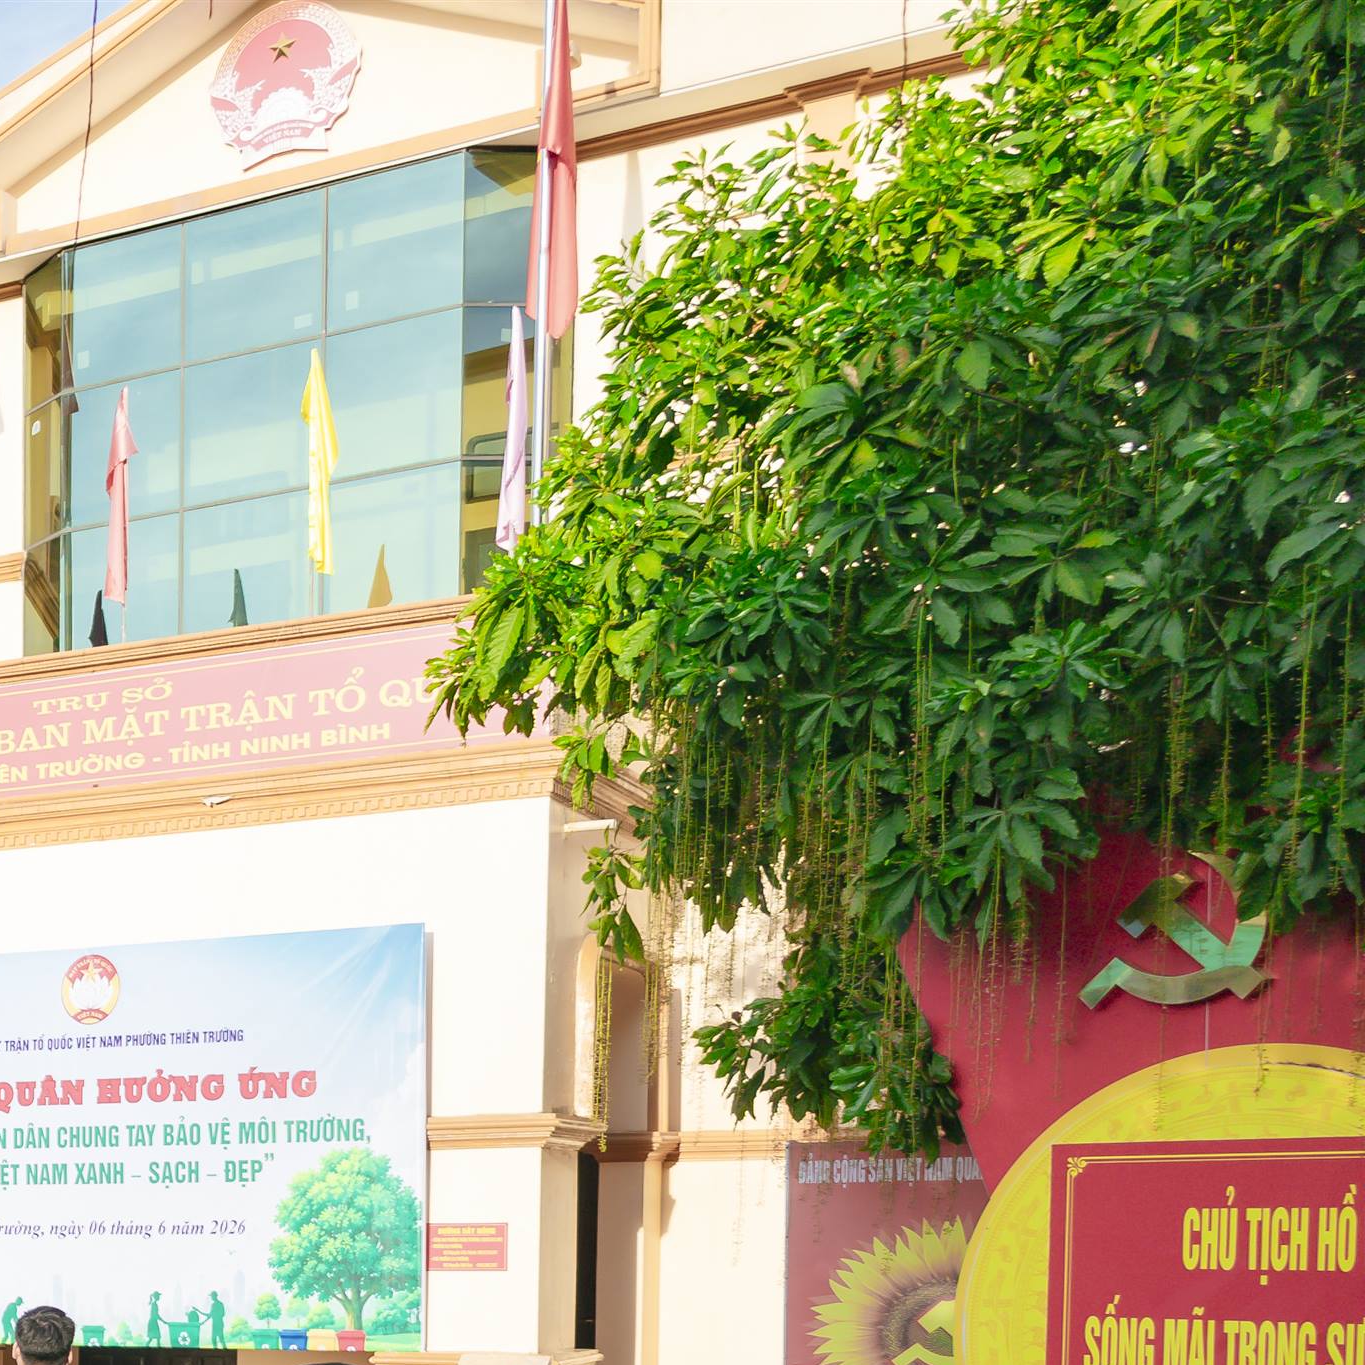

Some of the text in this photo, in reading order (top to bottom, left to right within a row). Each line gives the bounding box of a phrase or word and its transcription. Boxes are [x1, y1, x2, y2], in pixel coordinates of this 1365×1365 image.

[33, 677, 174, 716] TRỤ SỞ
[82, 706, 170, 747] MẶT
[180, 690, 303, 733] TRẬN
[308, 666, 366, 717] TỔ
[379, 677, 437, 708] QU
[36, 751, 145, 780] TRƯỜNG
[170, 737, 231, 765] TỈNH
[240, 730, 310, 756] NINH
[320, 722, 390, 748] BÌNH
[5, 1036, 29, 1054] TRẬN
[47, 1034, 73, 1051] QUỐC
[76, 1033, 96, 1051] VIỆT
[100, 1034, 122, 1048] NAM
[126, 1031, 166, 1047] PHƯỜNG
[170, 1029, 199, 1045] THIÊN
[203, 1027, 244, 1043] TRƯỜNG
[97, 1068, 225, 1104] HƯỞNG
[238, 1066, 317, 1100] ỨNG
[13, 1122, 50, 1149] DÂN
[57, 1126, 119, 1148] CHUNG
[126, 1124, 156, 1147] TAY
[163, 1115, 201, 1146] BẢO
[208, 1116, 231, 1150] VỆ
[239, 1116, 276, 1144] MÔI
[284, 1113, 370, 1144] TRƯỜNG,
[26, 1163, 68, 1185] NAM
[75, 1162, 124, 1184] XANH
[148, 1160, 199, 1189] SẠCH
[833, 1154, 866, 1188] CỘNG
[956, 1156, 984, 1184] QUA
[49, 1220, 84, 1239] ngày
[89, 1219, 107, 1235] 06
[110, 1220, 152, 1239] tháng
[158, 1219, 166, 1235] 6
[171, 1221, 204, 1235] năm
[210, 1219, 246, 1235] 2026
[1182, 1183, 1358, 1286] CHỦ TỊCH HỒ
